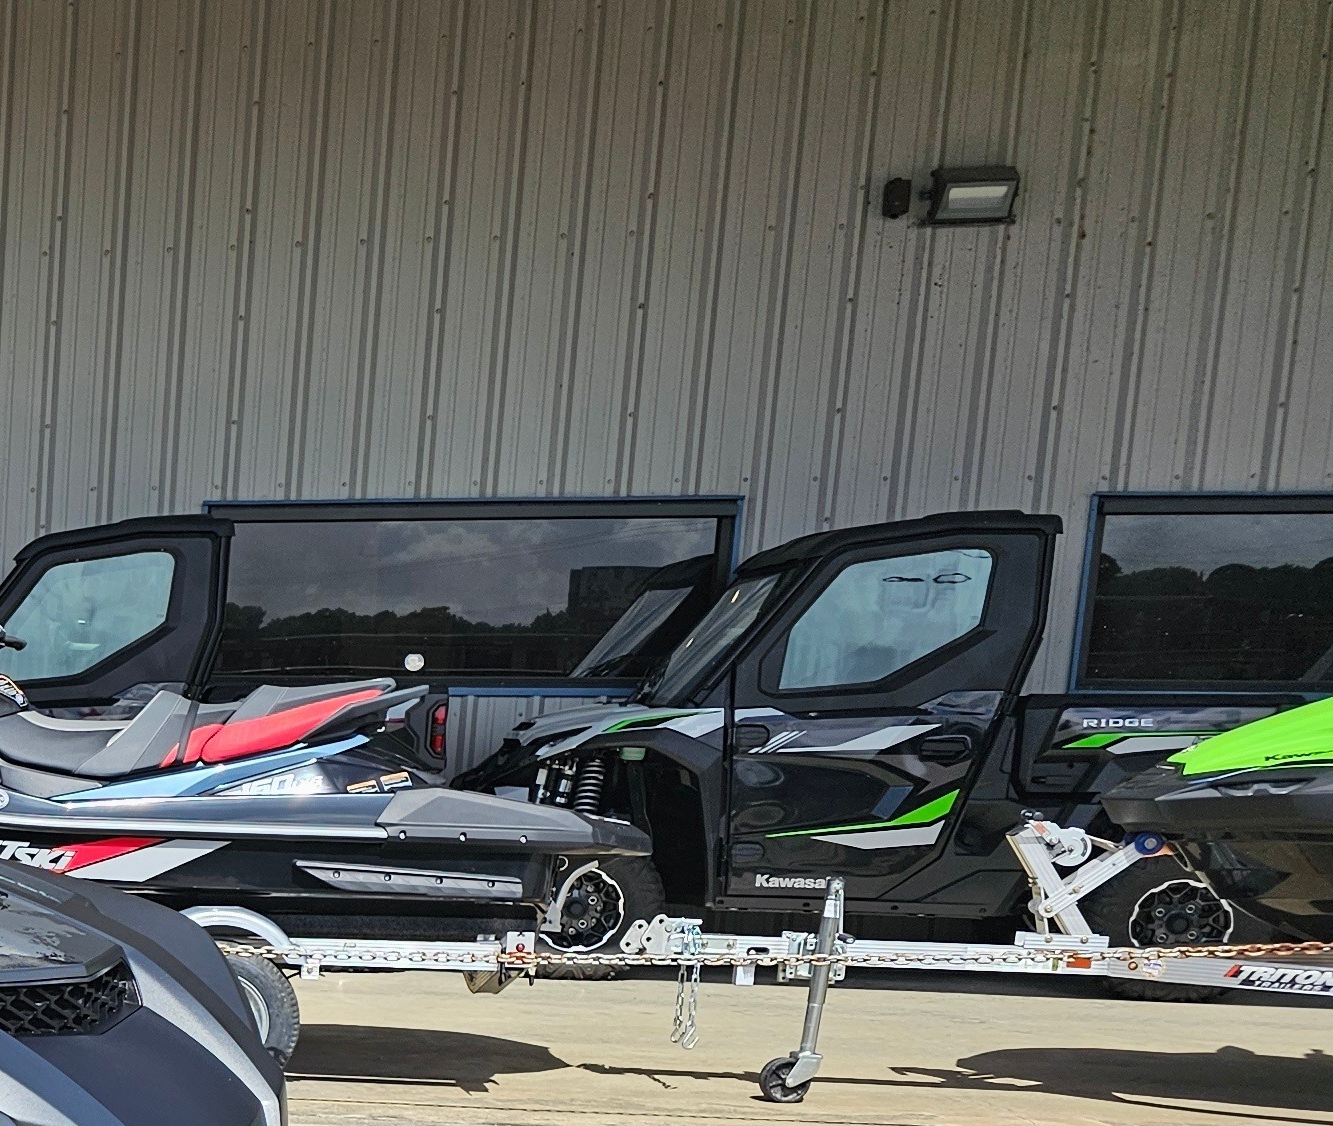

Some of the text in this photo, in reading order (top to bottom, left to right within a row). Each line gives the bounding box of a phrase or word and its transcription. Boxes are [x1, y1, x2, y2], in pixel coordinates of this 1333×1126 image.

[1082, 718, 1154, 728] RIDGE
[755, 873, 832, 889] Kawasa
[1238, 965, 1333, 987] TRITON
